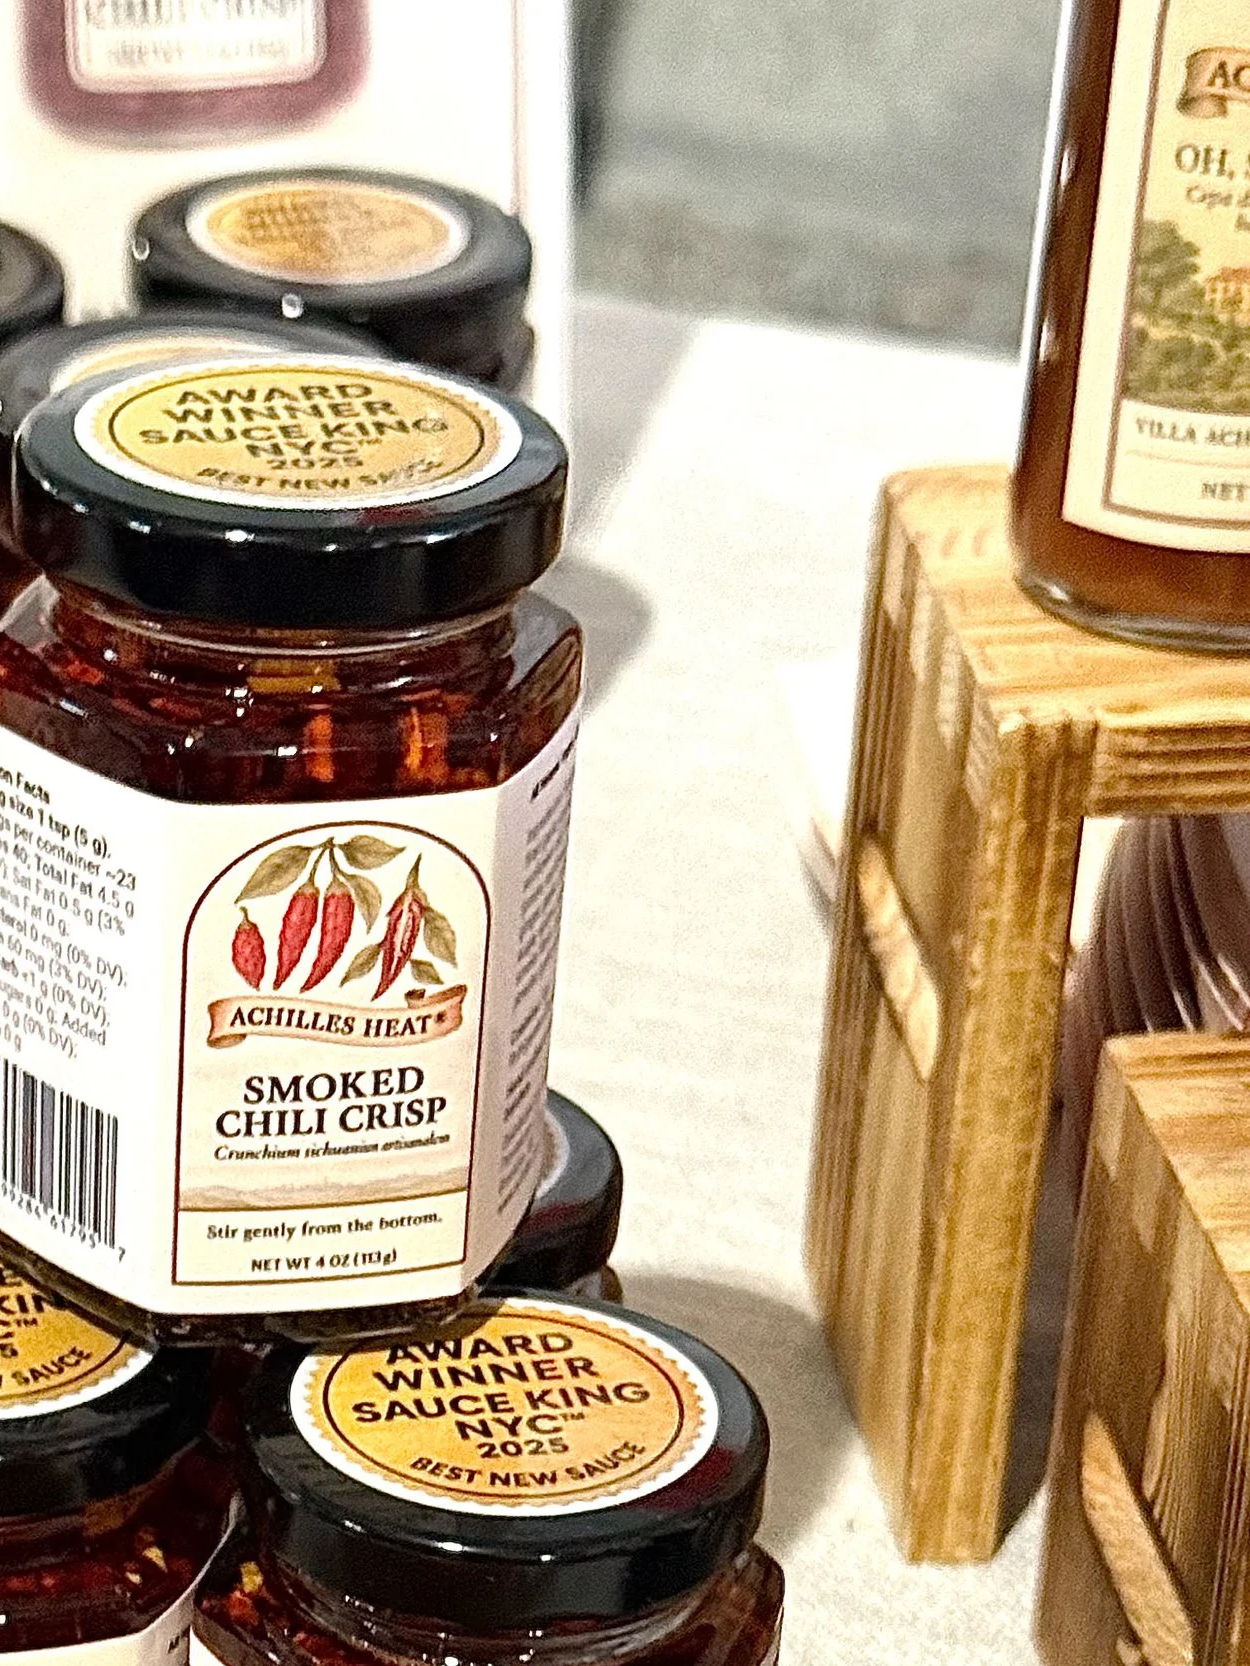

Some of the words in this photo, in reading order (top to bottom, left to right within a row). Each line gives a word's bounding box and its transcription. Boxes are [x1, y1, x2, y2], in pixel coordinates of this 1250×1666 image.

[176, 383, 374, 405] AWARD
[161, 401, 399, 423] WINNER
[139, 423, 313, 445] SAUCE
[321, 417, 449, 441] KING
[265, 456, 364, 471] 2025
[195, 467, 269, 488] BEST
[278, 477, 352, 492] NEW
[229, 1006, 356, 1036] ACHILLES
[243, 1065, 425, 1106] SMOKED
[215, 1108, 327, 1139] CHILI
[339, 1096, 448, 1133] CRISP
[206, 1223, 239, 1240] Stir
[243, 1221, 297, 1243] gently
[301, 1219, 342, 1237] from
[347, 1216, 374, 1234] the
[379, 1211, 444, 1231] bottom.
[251, 1257, 281, 1273] NET
[286, 1256, 311, 1272] WT
[315, 1254, 326, 1270] 4
[329, 1252, 350, 1269] OZ
[386, 1332, 574, 1366] AWARD
[12, 1345, 92, 1386] SAUCE
[372, 1355, 601, 1391] WINNER
[351, 1392, 516, 1423] SAUCE
[528, 1381, 650, 1411] KING
[410, 1456, 483, 1486] BEST
[488, 1470, 558, 1488] NEW
[566, 1439, 647, 1482] SAUCE
[477, 1437, 570, 1459] 2025
